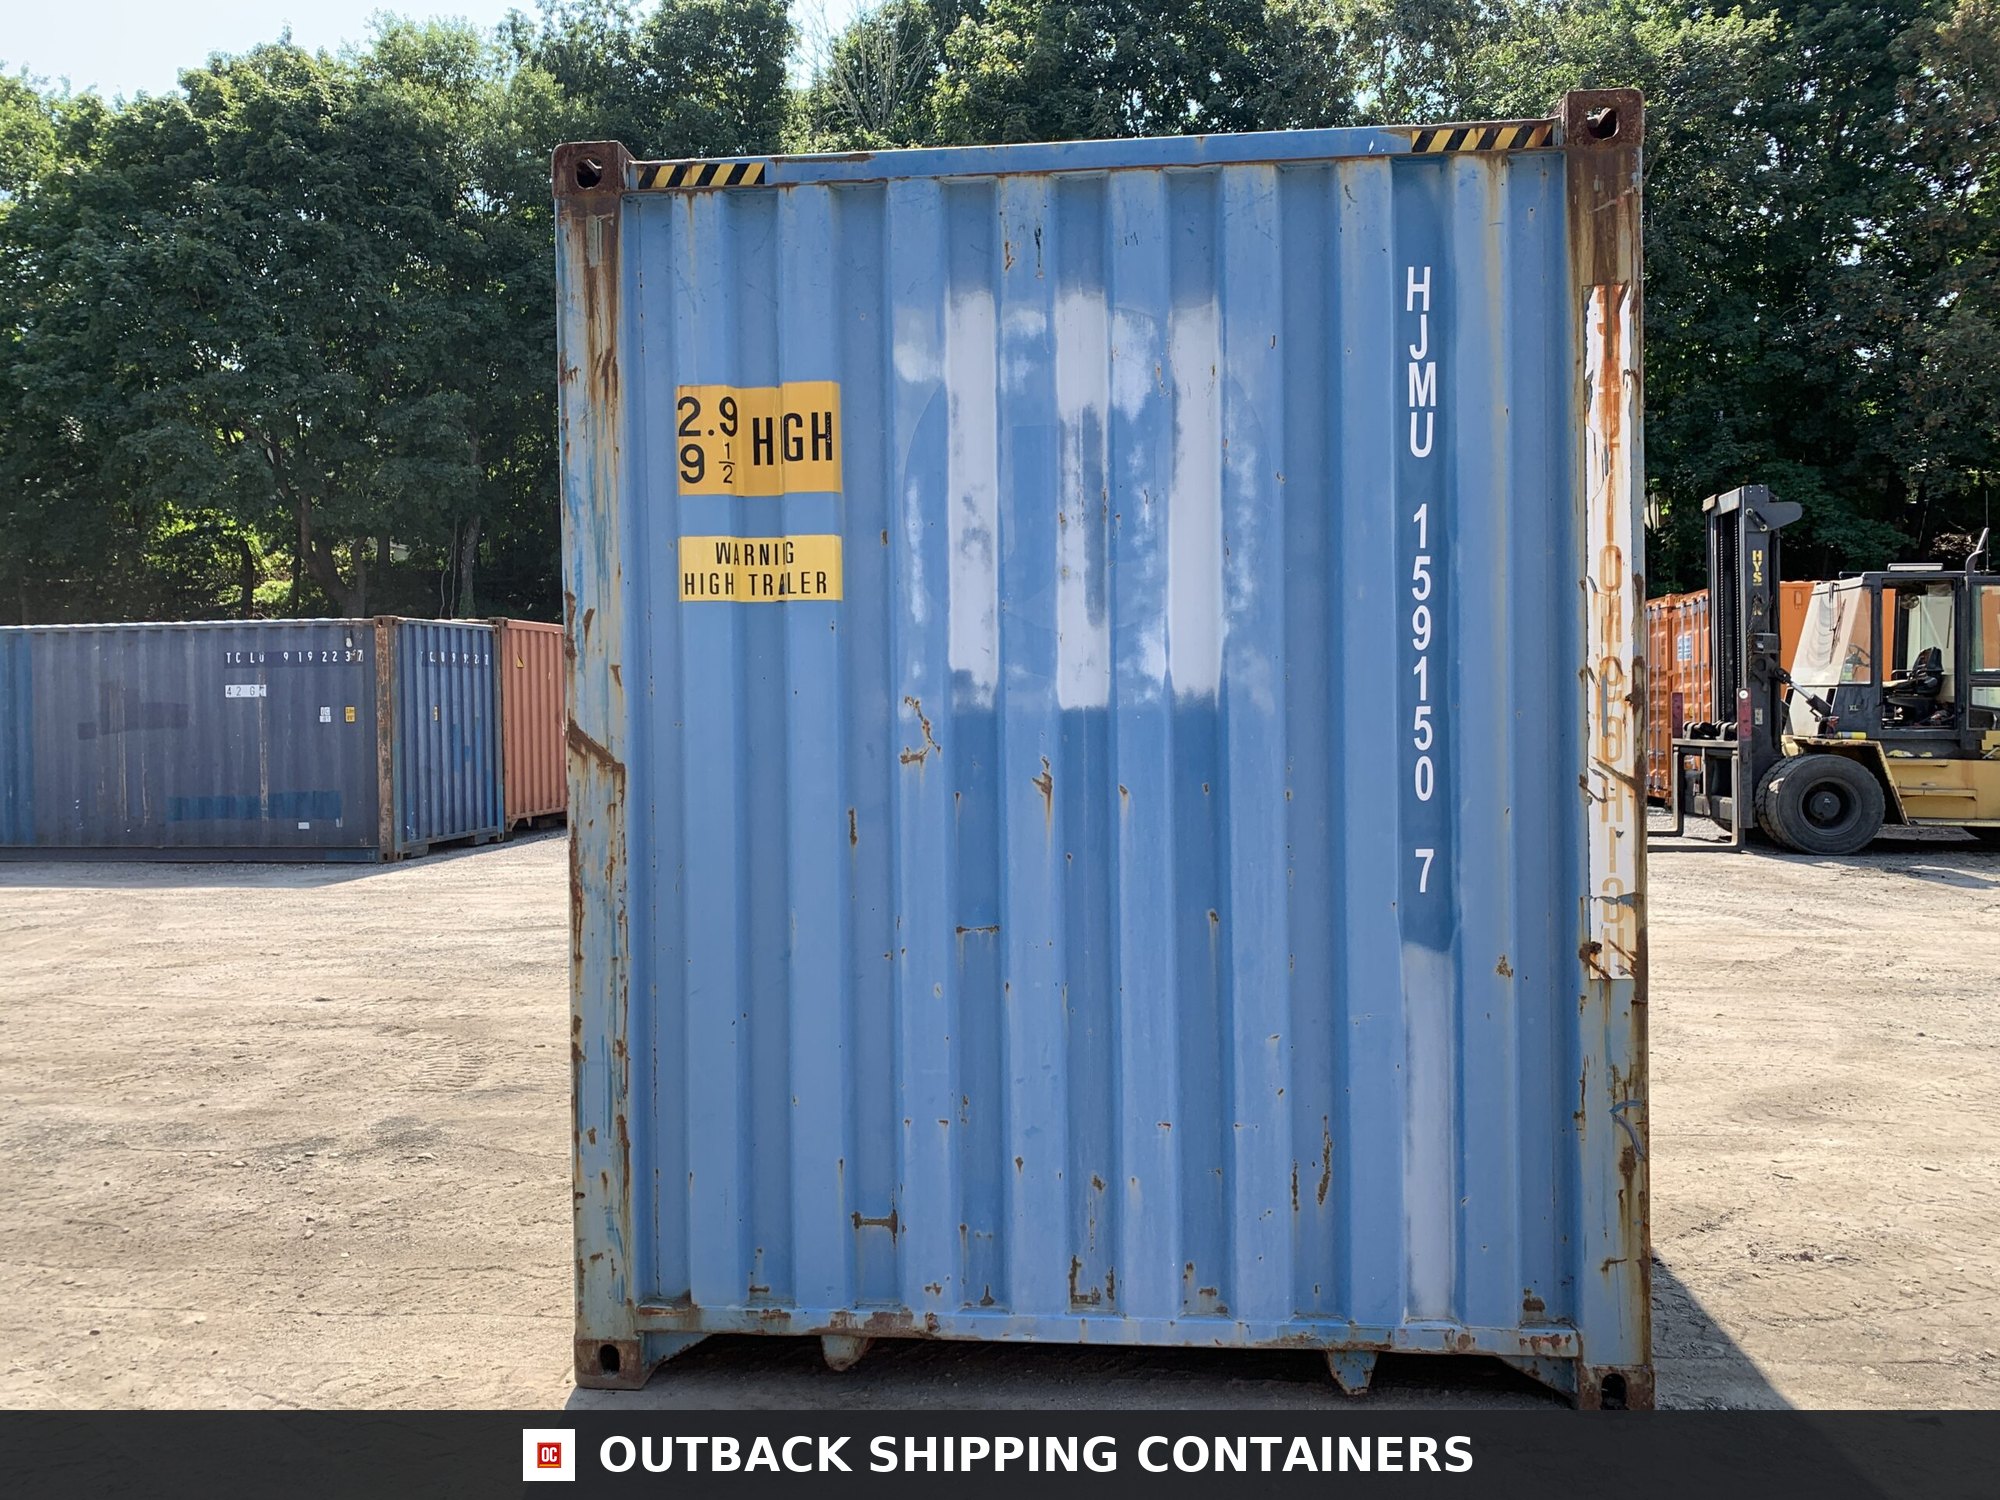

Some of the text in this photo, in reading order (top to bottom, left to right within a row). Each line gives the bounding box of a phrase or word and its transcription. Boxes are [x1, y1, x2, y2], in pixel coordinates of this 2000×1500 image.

[677, 396, 738, 437] 2.9
[752, 411, 833, 466] HGH
[684, 570, 827, 596] HIGH TRALER
[1406, 266, 1437, 893] HJMU 159150 7
[226, 651, 265, 664] TCLU
